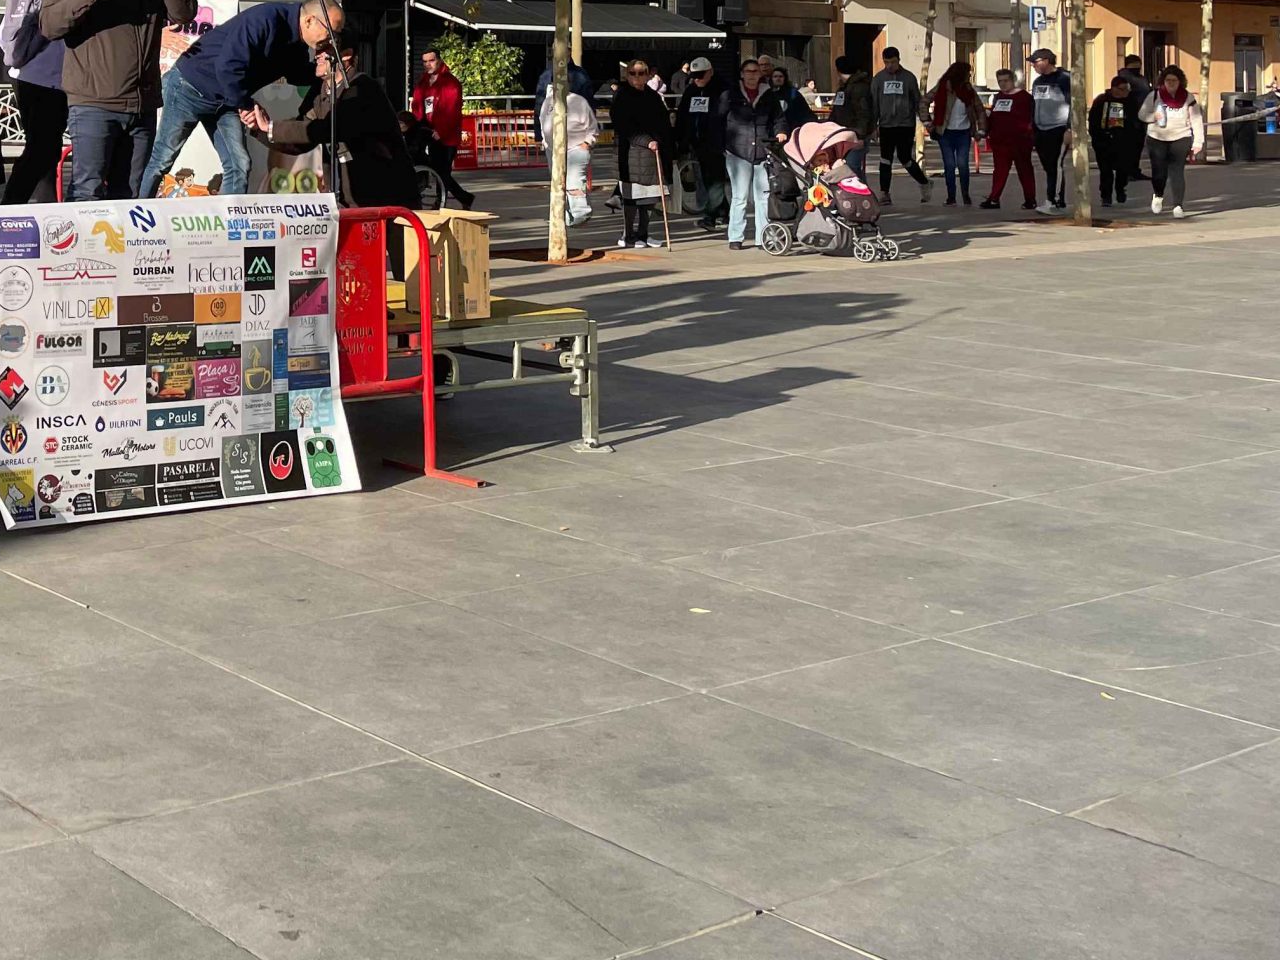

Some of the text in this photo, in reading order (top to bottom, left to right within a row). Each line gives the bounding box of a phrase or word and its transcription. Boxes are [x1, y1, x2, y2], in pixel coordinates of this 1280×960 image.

[2, 221, 34, 229] COVETA
[171, 215, 226, 232] SUMA
[227, 218, 251, 230] AQUA
[251, 221, 275, 231] esport
[126, 238, 167, 247] nutrinovex
[133, 265, 175, 276] DURBAN
[188, 262, 243, 283] helena
[42, 297, 110, 320] VINILDEX
[36, 334, 83, 350] FULGOR
[150, 333, 166, 347] Bar
[36, 414, 87, 430] INSCA
[168, 411, 197, 424] Pauls
[45, 442, 57, 450] STC
[61, 435, 89, 444] STOCK
[179, 436, 214, 452] UCOVI
[61, 443, 93, 452] CERAMIC
[163, 461, 216, 477] PASARELA
